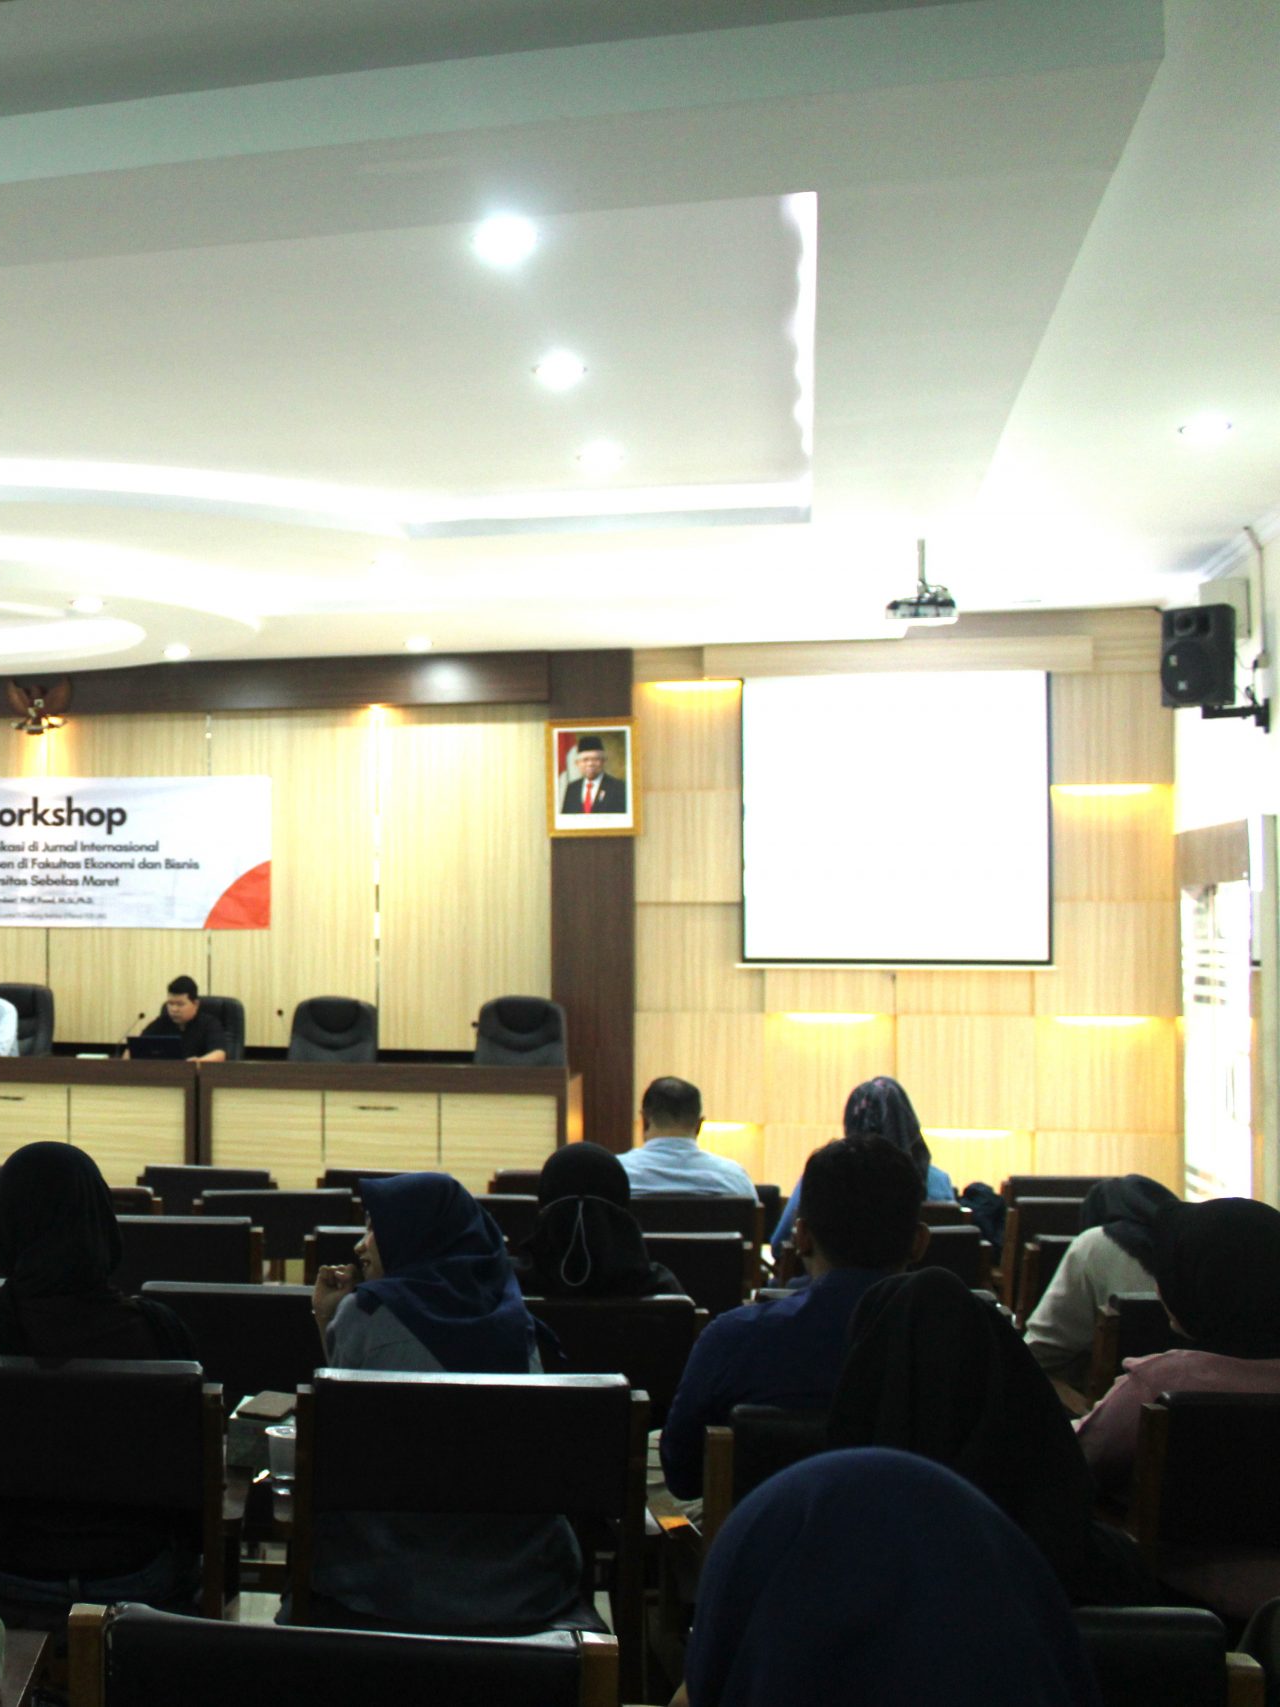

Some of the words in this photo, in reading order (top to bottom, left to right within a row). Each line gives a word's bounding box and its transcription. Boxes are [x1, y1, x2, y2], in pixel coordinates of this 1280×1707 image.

[28, 840, 39, 852] di
[42, 840, 77, 852] Jurnal
[80, 840, 159, 852] Internasional
[17, 858, 28, 869] di
[31, 858, 81, 869] Fakultas
[84, 858, 135, 869] Ekonomi
[138, 858, 162, 869] dan
[164, 858, 199, 870] Bisnis
[30, 875, 79, 886] Sebelas
[82, 875, 119, 886] Maret
